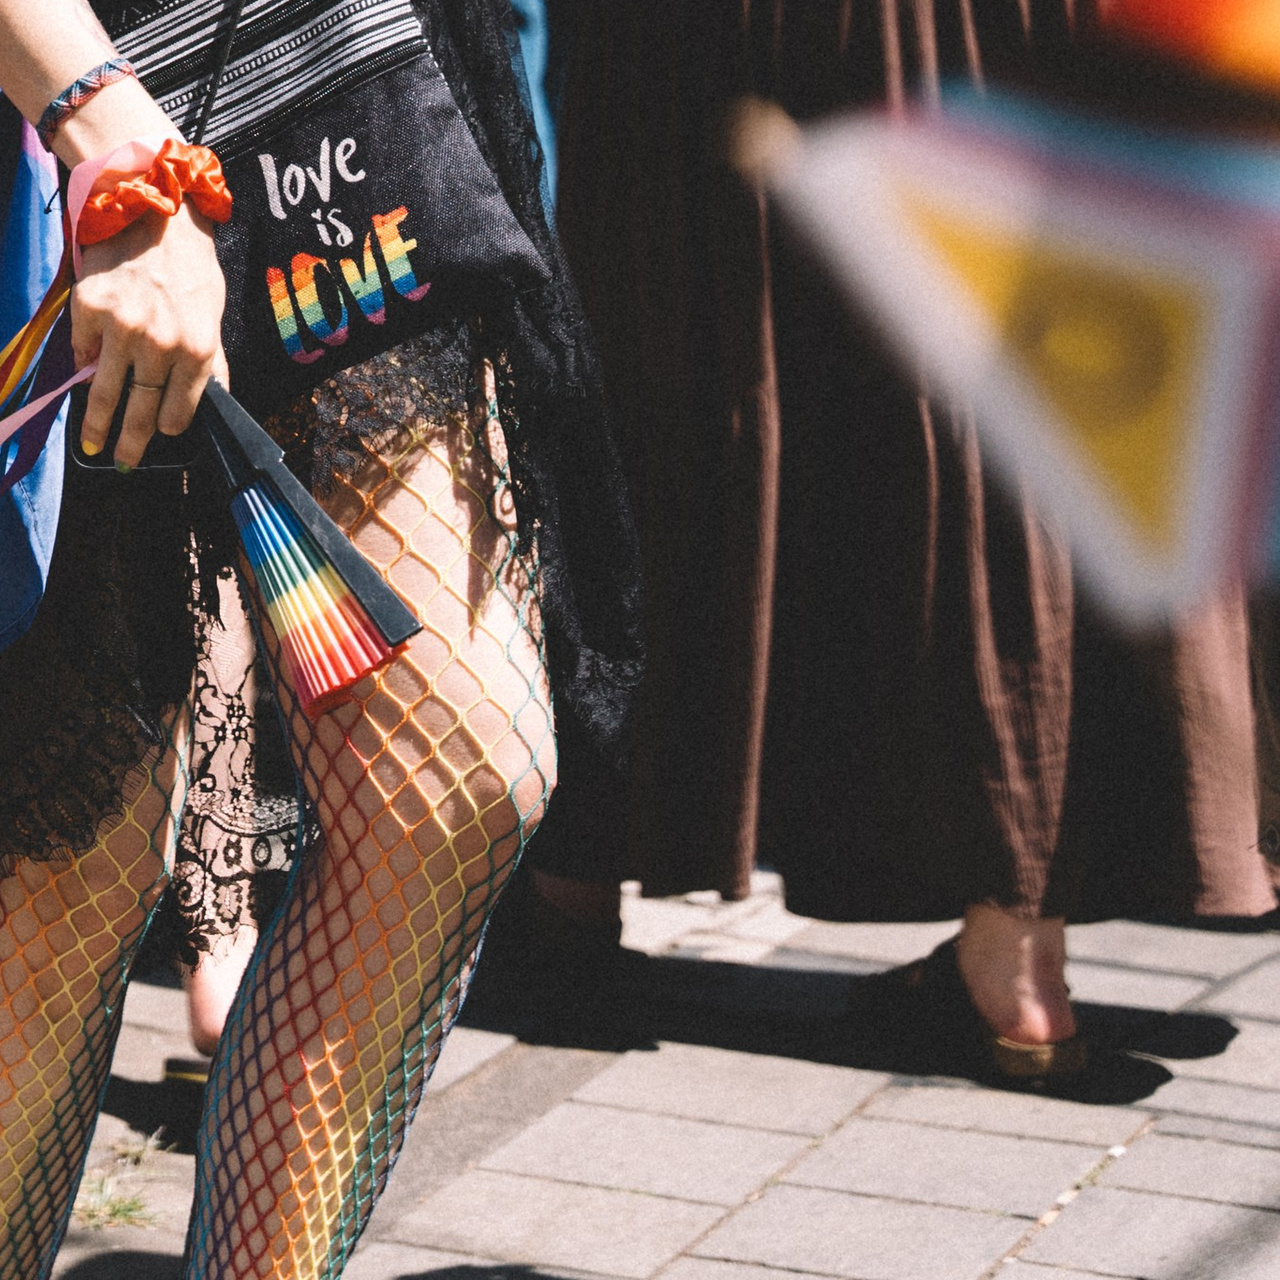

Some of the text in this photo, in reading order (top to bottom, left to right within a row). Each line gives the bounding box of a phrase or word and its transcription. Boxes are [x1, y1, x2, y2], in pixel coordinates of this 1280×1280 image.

[258, 136, 366, 220] love
[311, 208, 354, 247] is
[266, 205, 431, 365] LOVE
